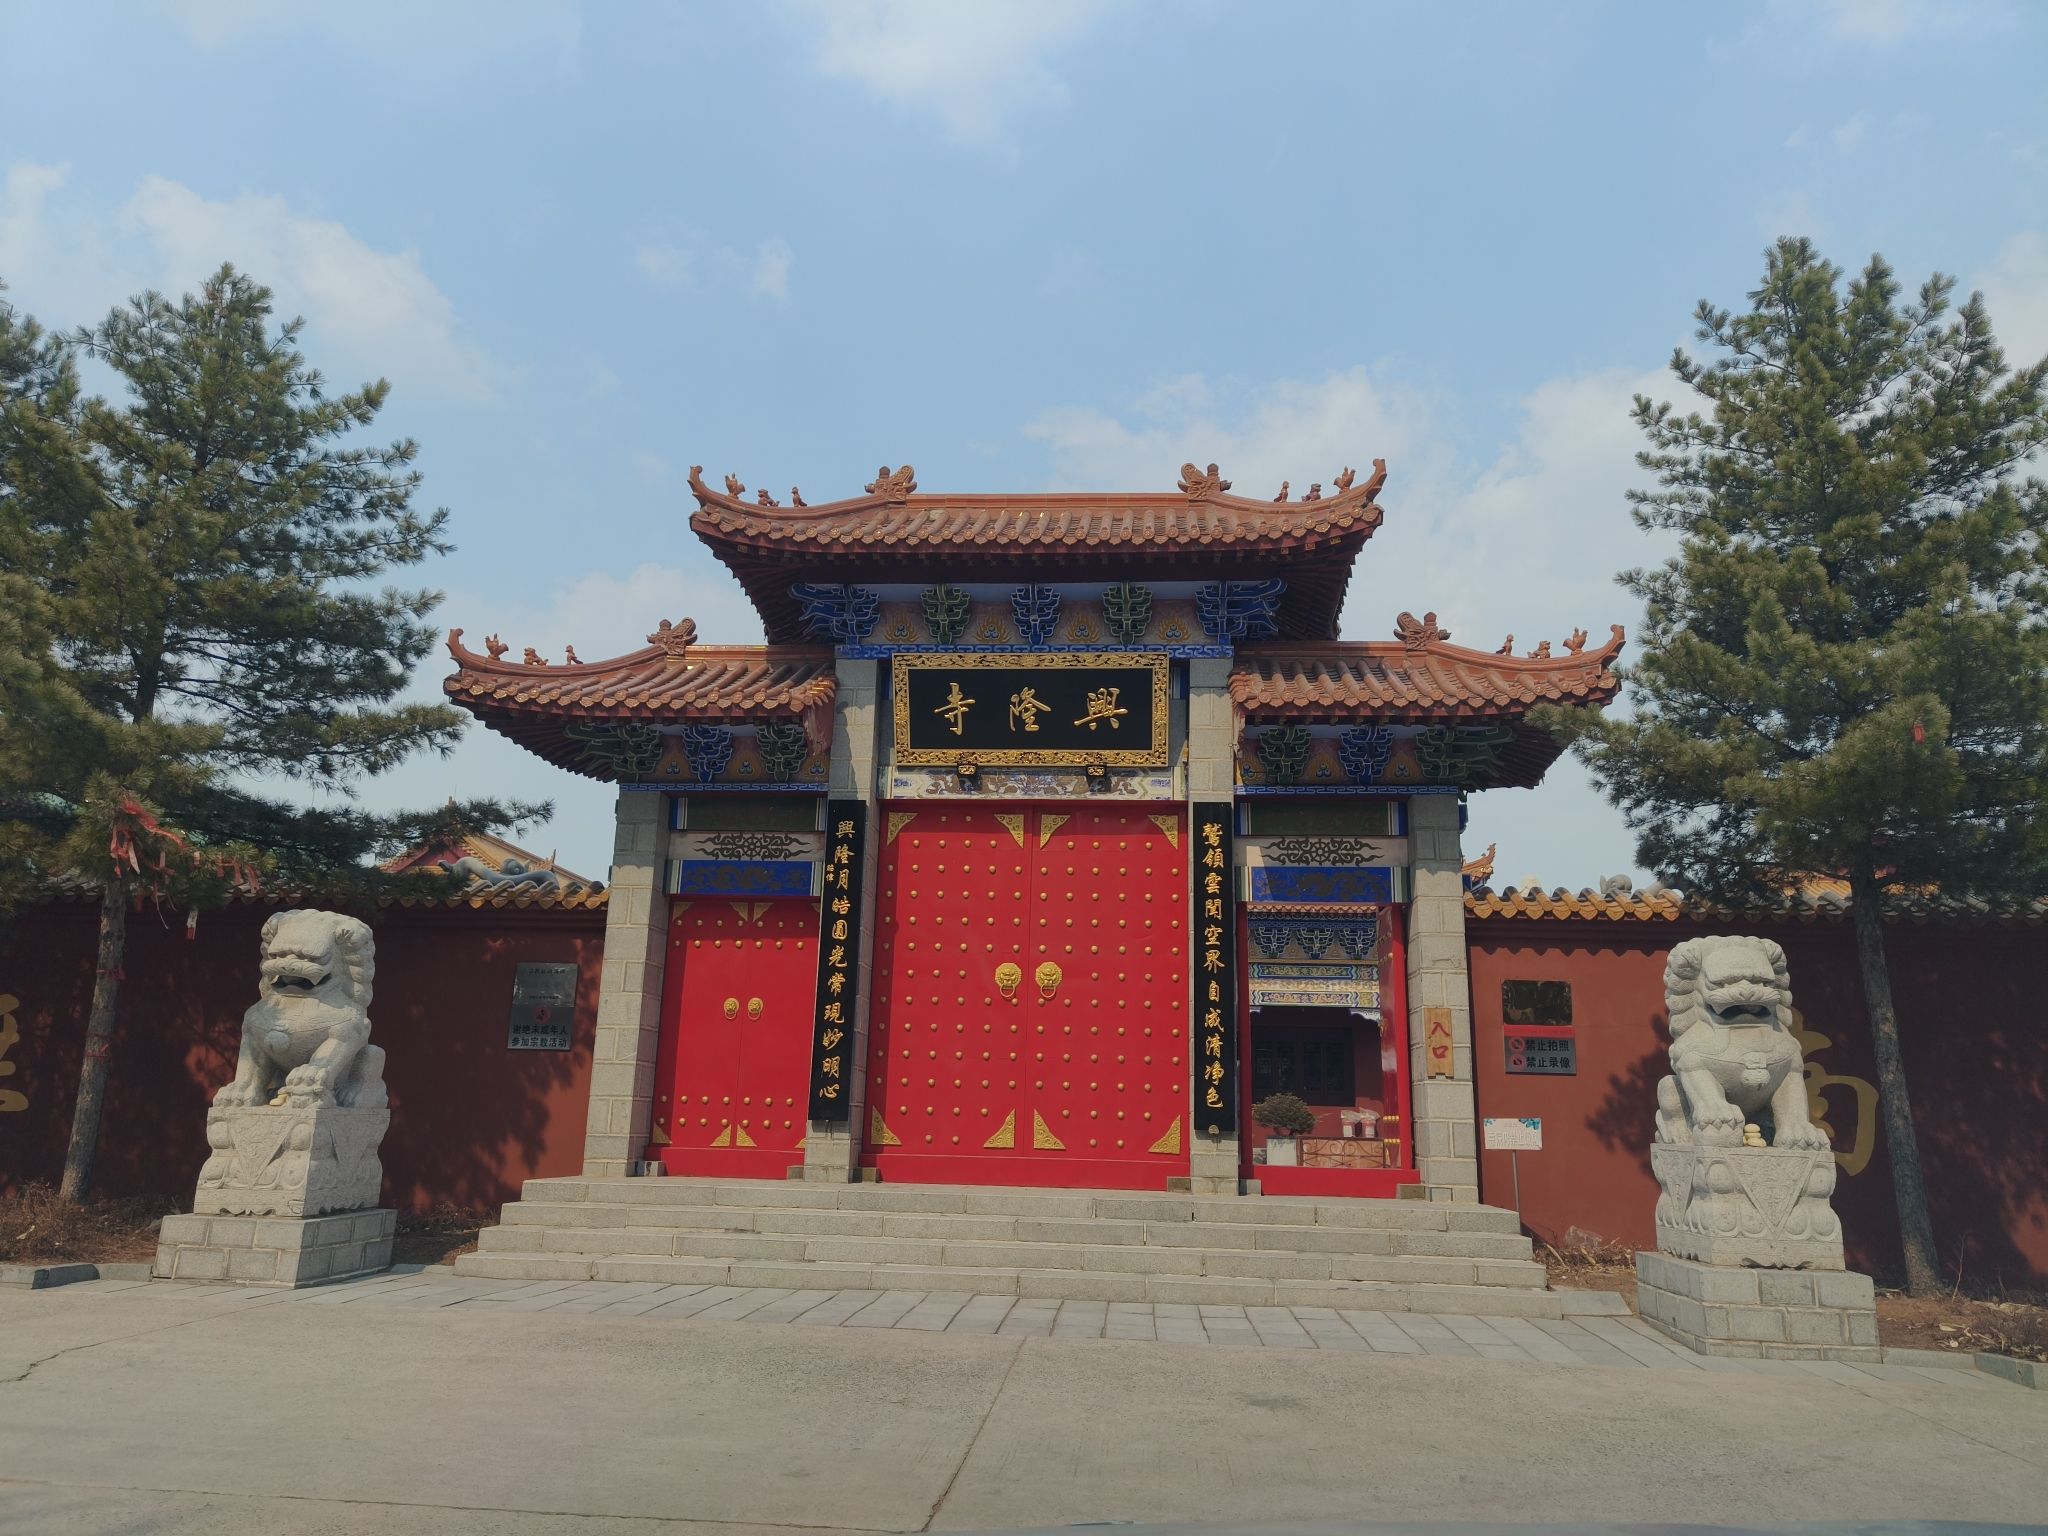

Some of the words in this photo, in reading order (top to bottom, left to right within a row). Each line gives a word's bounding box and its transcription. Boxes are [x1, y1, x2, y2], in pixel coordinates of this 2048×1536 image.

[511, 1037, 567, 1048] 参加宗教活动
[1430, 1021, 1451, 1060] 入口
[1525, 1039, 1570, 1052] 禁止拍照
[1525, 1056, 1571, 1069] 禁止录像
